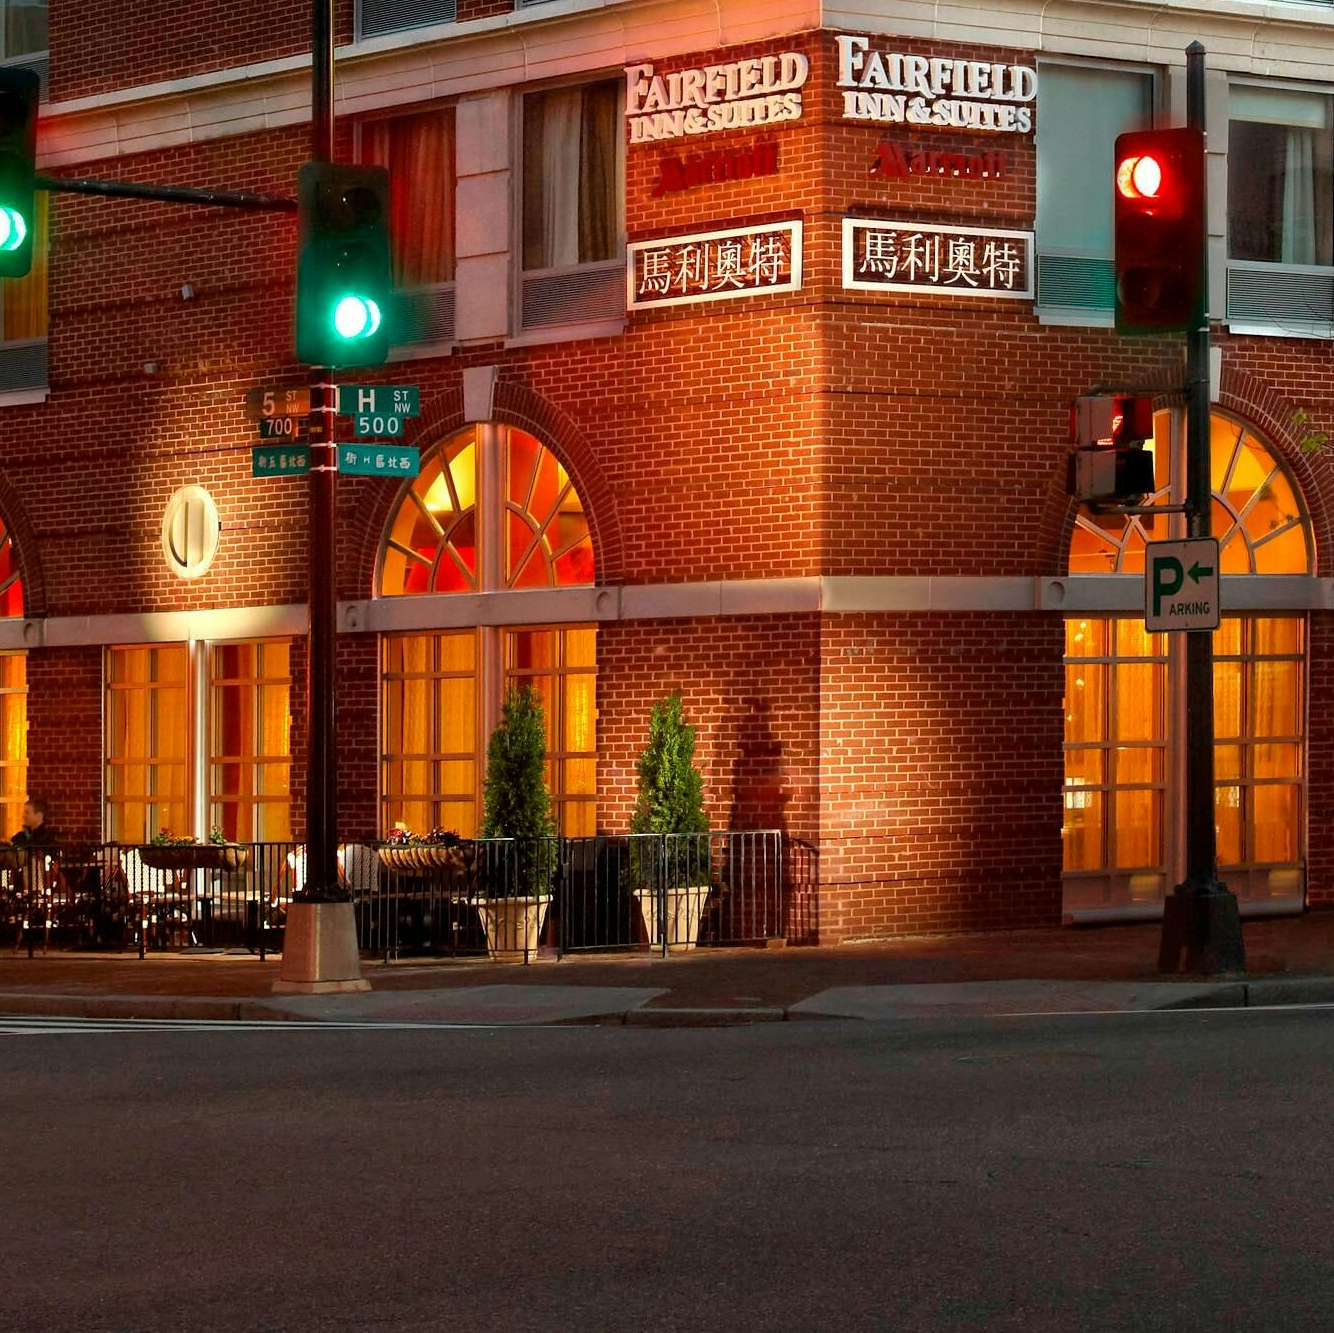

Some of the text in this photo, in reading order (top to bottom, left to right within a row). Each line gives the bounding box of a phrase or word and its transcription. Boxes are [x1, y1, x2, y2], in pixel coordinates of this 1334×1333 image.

[835, 35, 1038, 102] FAIRFIELD
[624, 52, 809, 115] FAIRFIELD
[639, 236, 785, 294] 馬利奧特
[859, 230, 1021, 290] 馬利奧特
[262, 390, 298, 416] 5 ST
[286, 401, 300, 414] NW
[358, 388, 409, 413] H ST
[394, 402, 411, 414] NW
[267, 417, 293, 436] 700
[359, 416, 399, 434] 500
